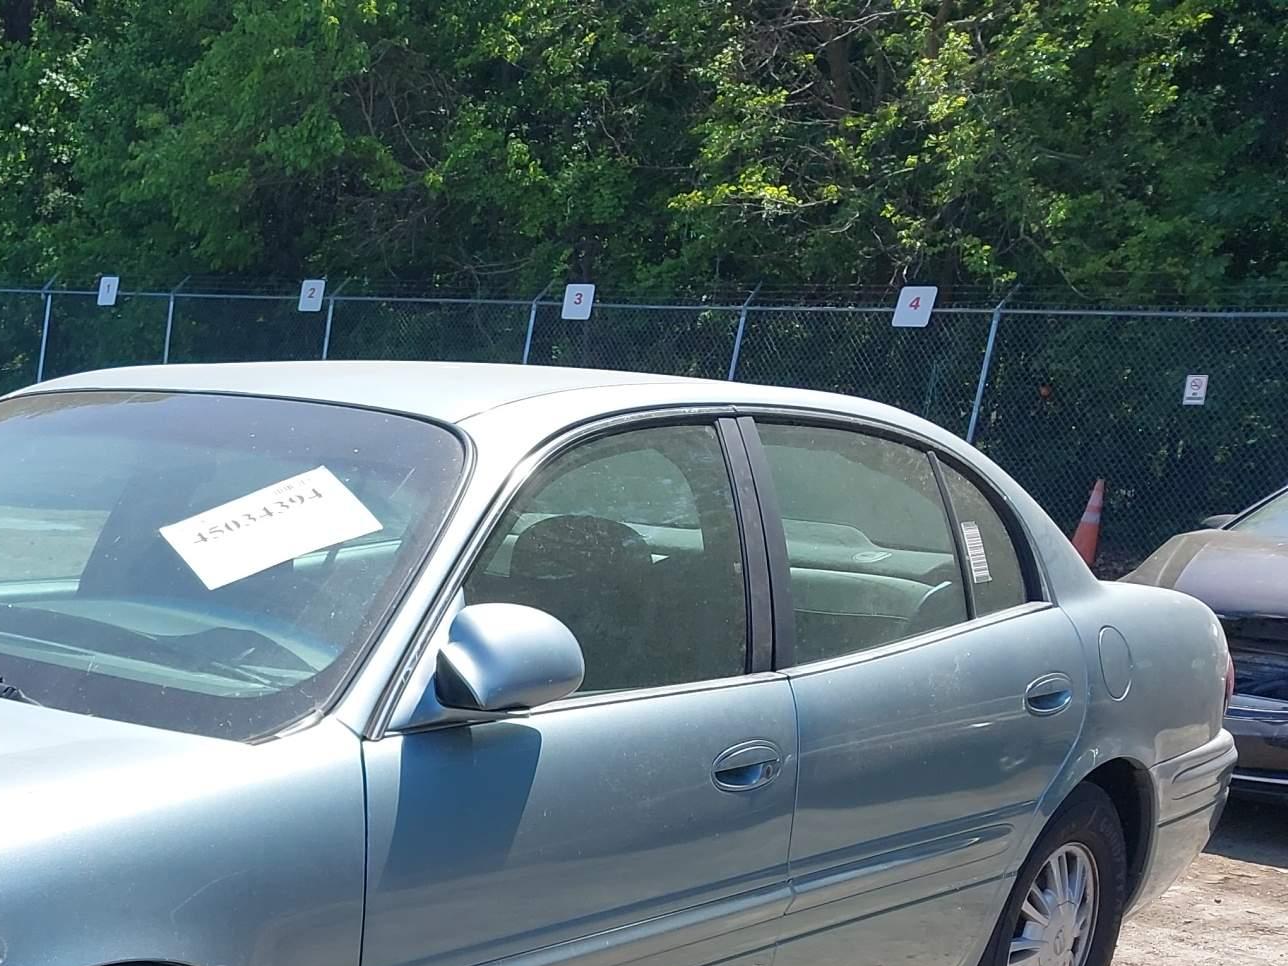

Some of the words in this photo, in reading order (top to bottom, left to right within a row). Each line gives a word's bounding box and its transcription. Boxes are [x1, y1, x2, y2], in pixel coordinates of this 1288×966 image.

[307, 287, 316, 298] 2
[573, 292, 583, 305] 3
[909, 296, 921, 311] 4
[193, 487, 325, 545] 45034394
